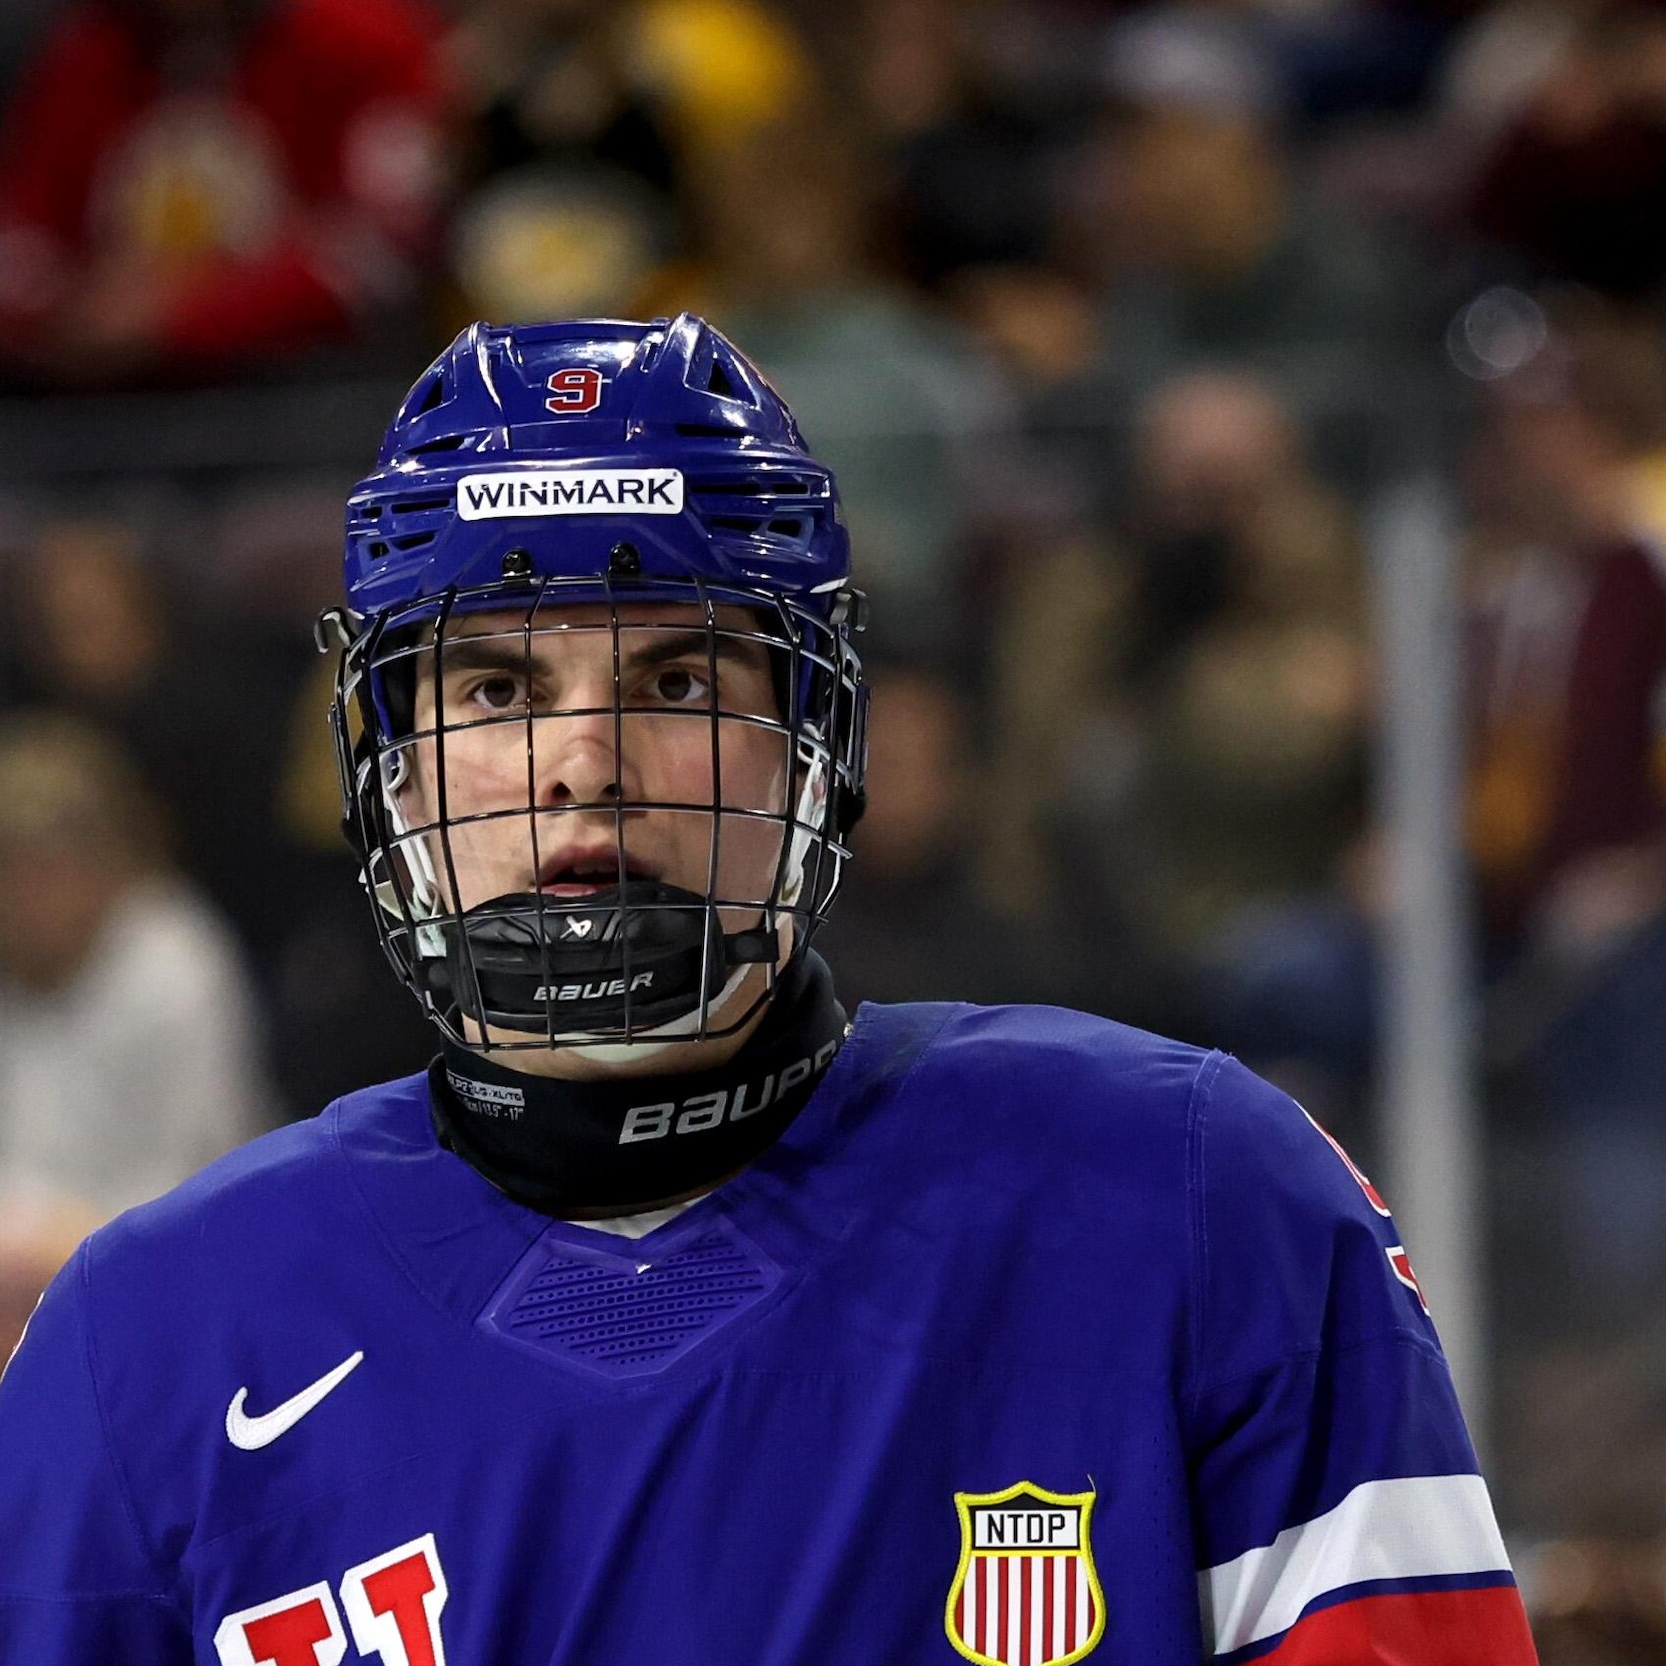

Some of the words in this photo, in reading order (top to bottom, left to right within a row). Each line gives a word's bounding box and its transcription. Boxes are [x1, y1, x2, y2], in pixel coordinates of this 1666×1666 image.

[545, 368, 603, 414] 9
[465, 478, 676, 511] WINMARK
[987, 1513, 1066, 1544] NTDP
